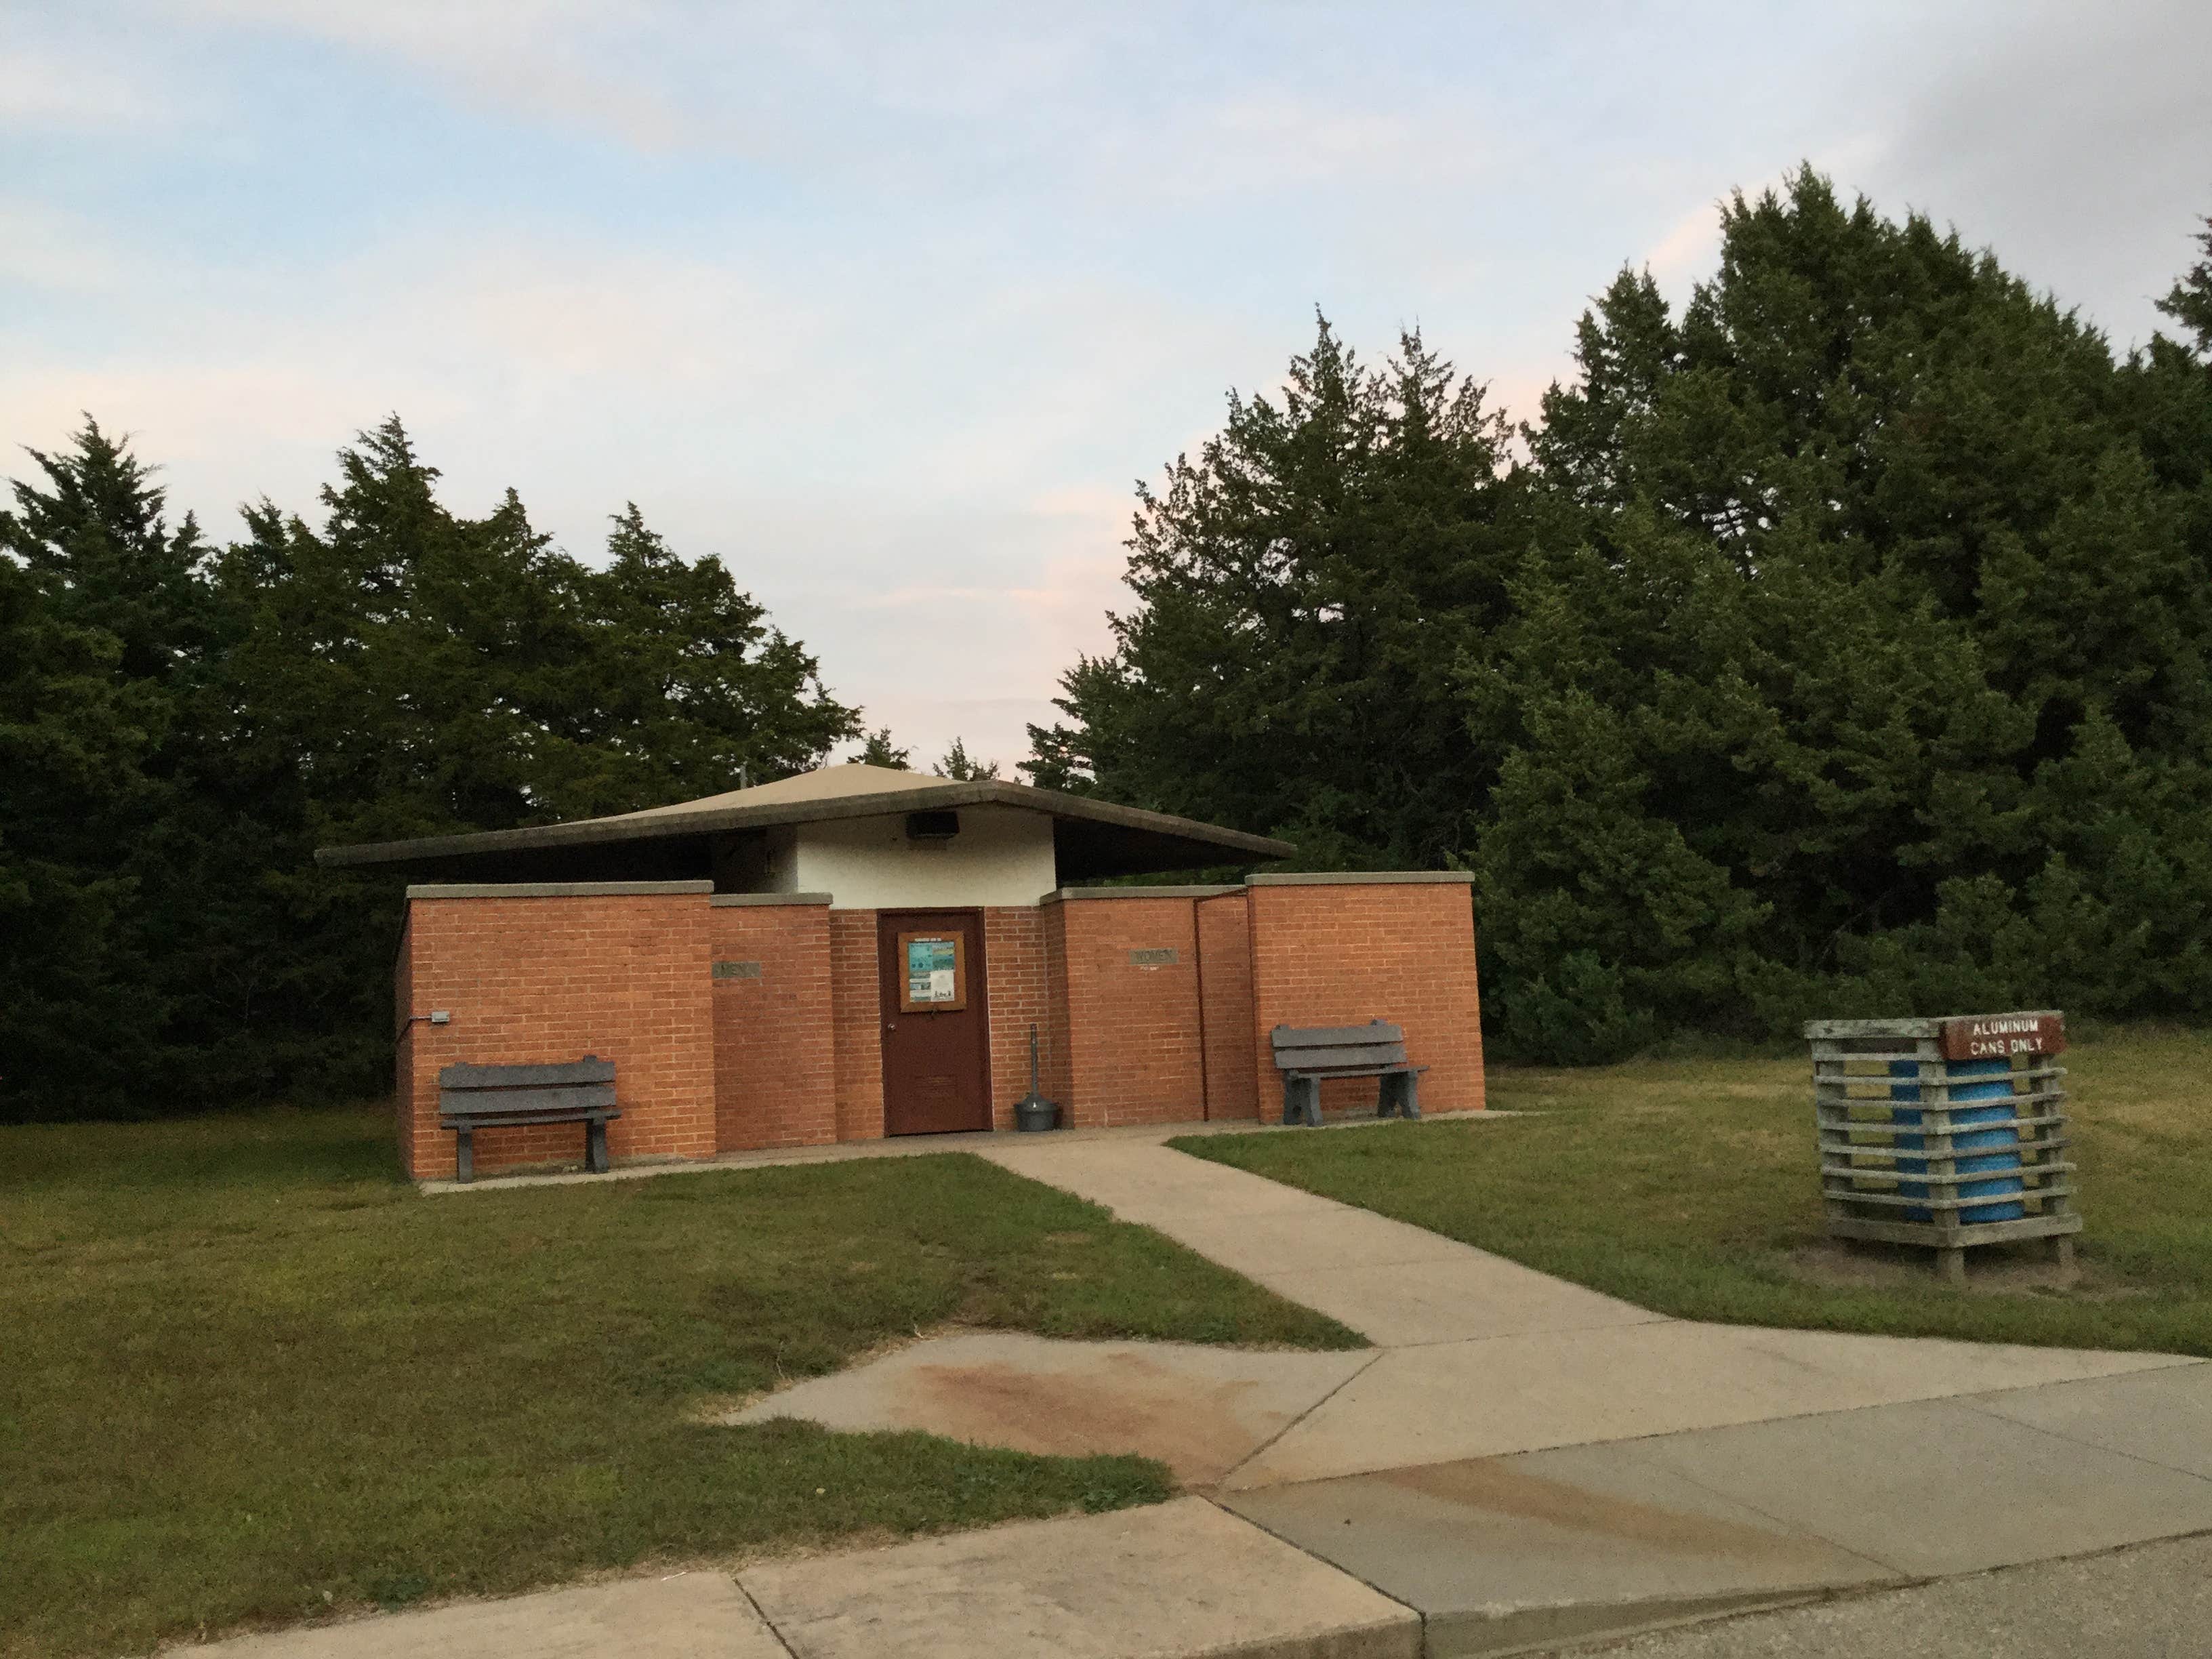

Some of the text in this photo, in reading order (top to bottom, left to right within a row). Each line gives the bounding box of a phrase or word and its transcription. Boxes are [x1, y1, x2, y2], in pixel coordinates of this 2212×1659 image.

[1134, 949, 1173, 962] WOMEN
[1973, 1019, 2038, 1036] ALUMINUM
[1970, 1037, 2042, 1055] CANS ONLY
